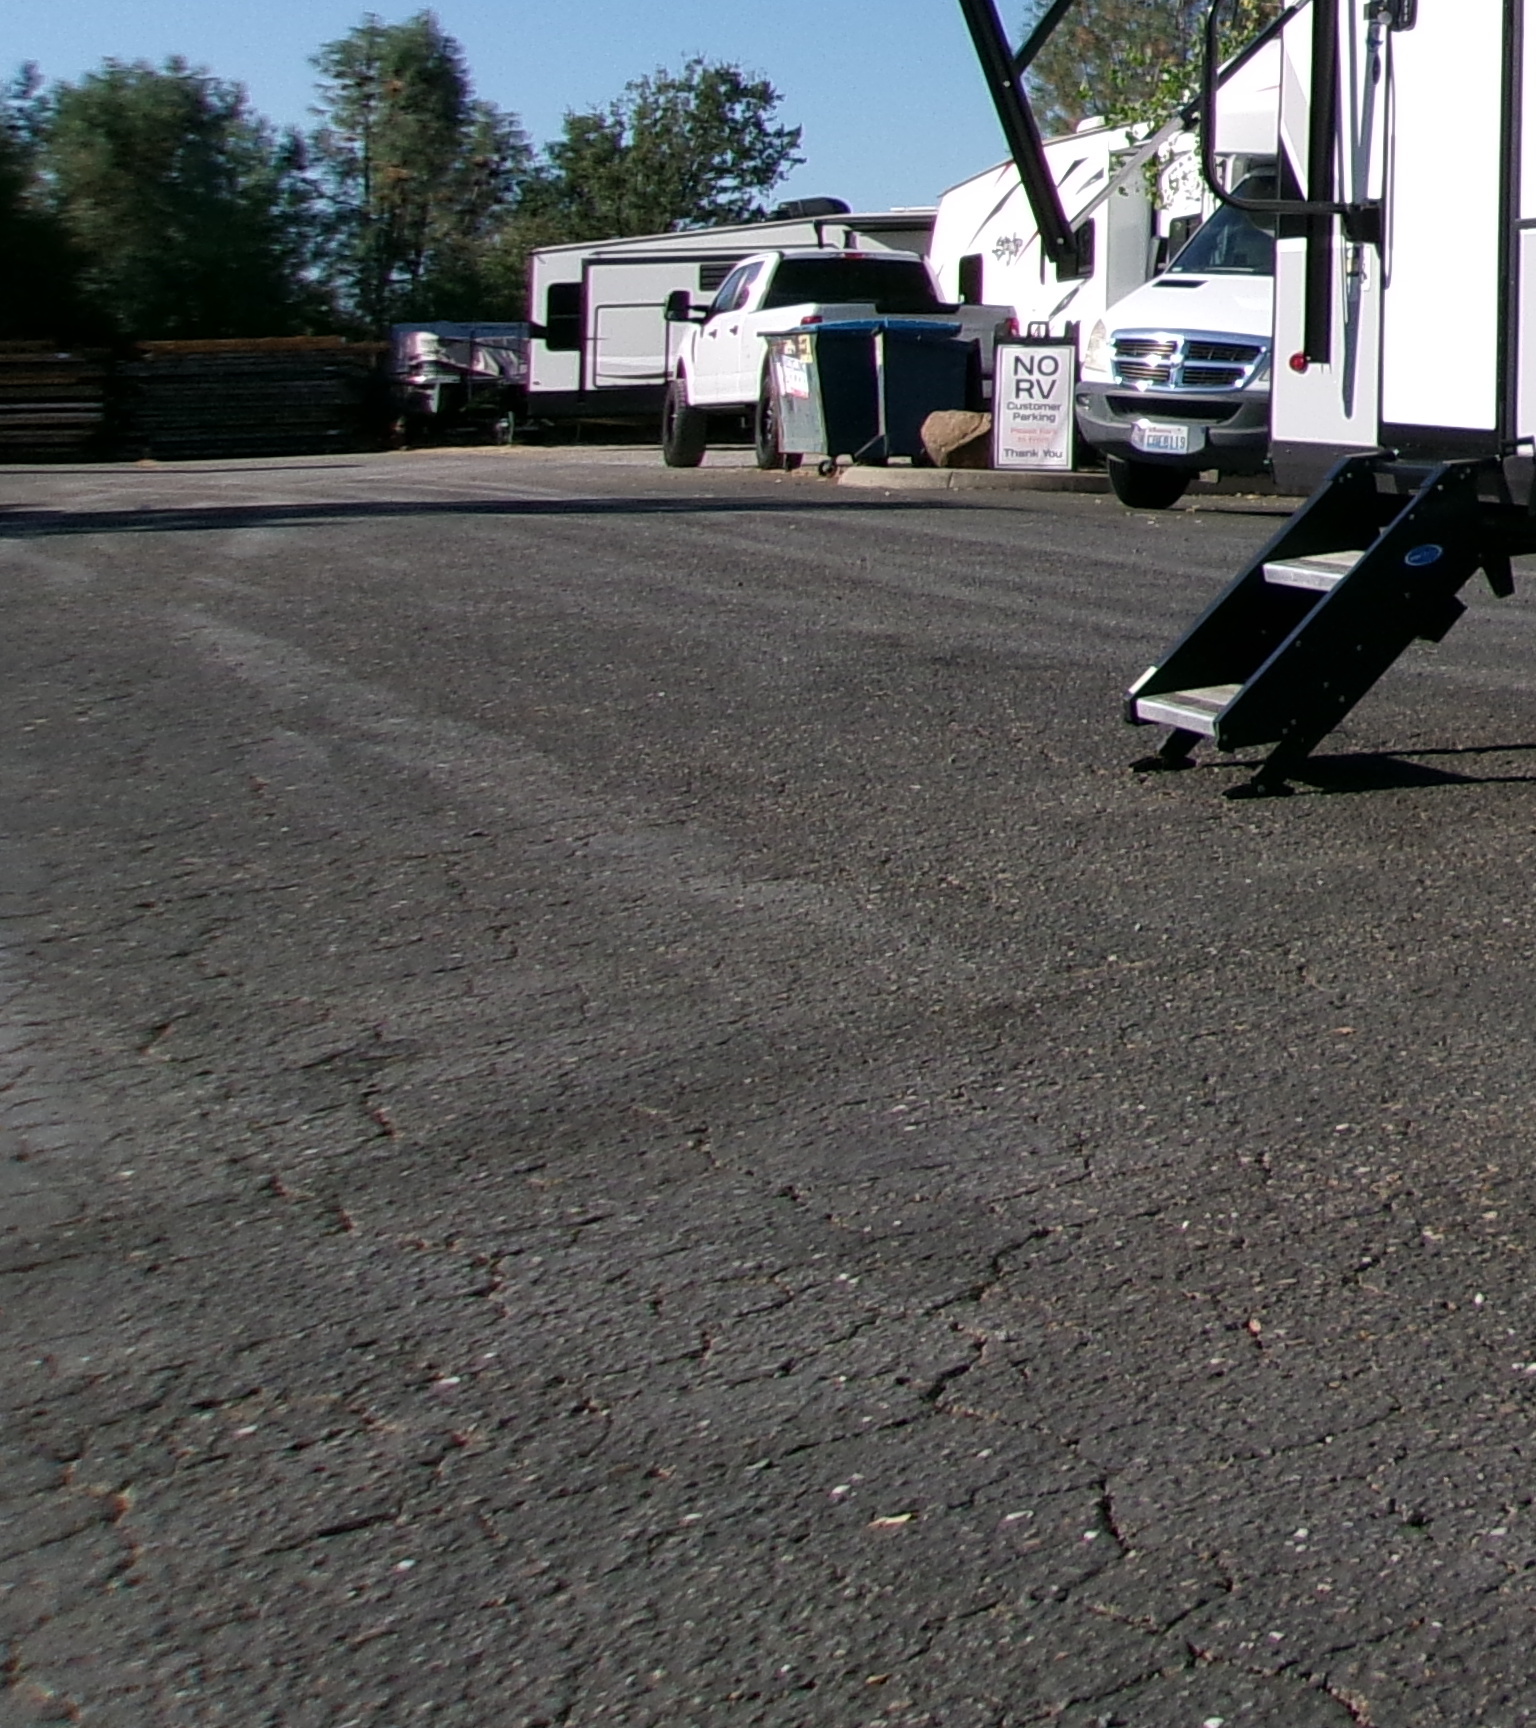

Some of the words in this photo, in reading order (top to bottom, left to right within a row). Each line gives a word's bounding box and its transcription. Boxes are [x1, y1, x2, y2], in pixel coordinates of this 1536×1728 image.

[1013, 355, 1059, 377] NO
[1014, 379, 1057, 400] RV
[1006, 401, 1062, 411] Customer
[1012, 412, 1056, 424] Parking
[1003, 448, 1039, 459] Thank
[1042, 448, 1063, 459] You
